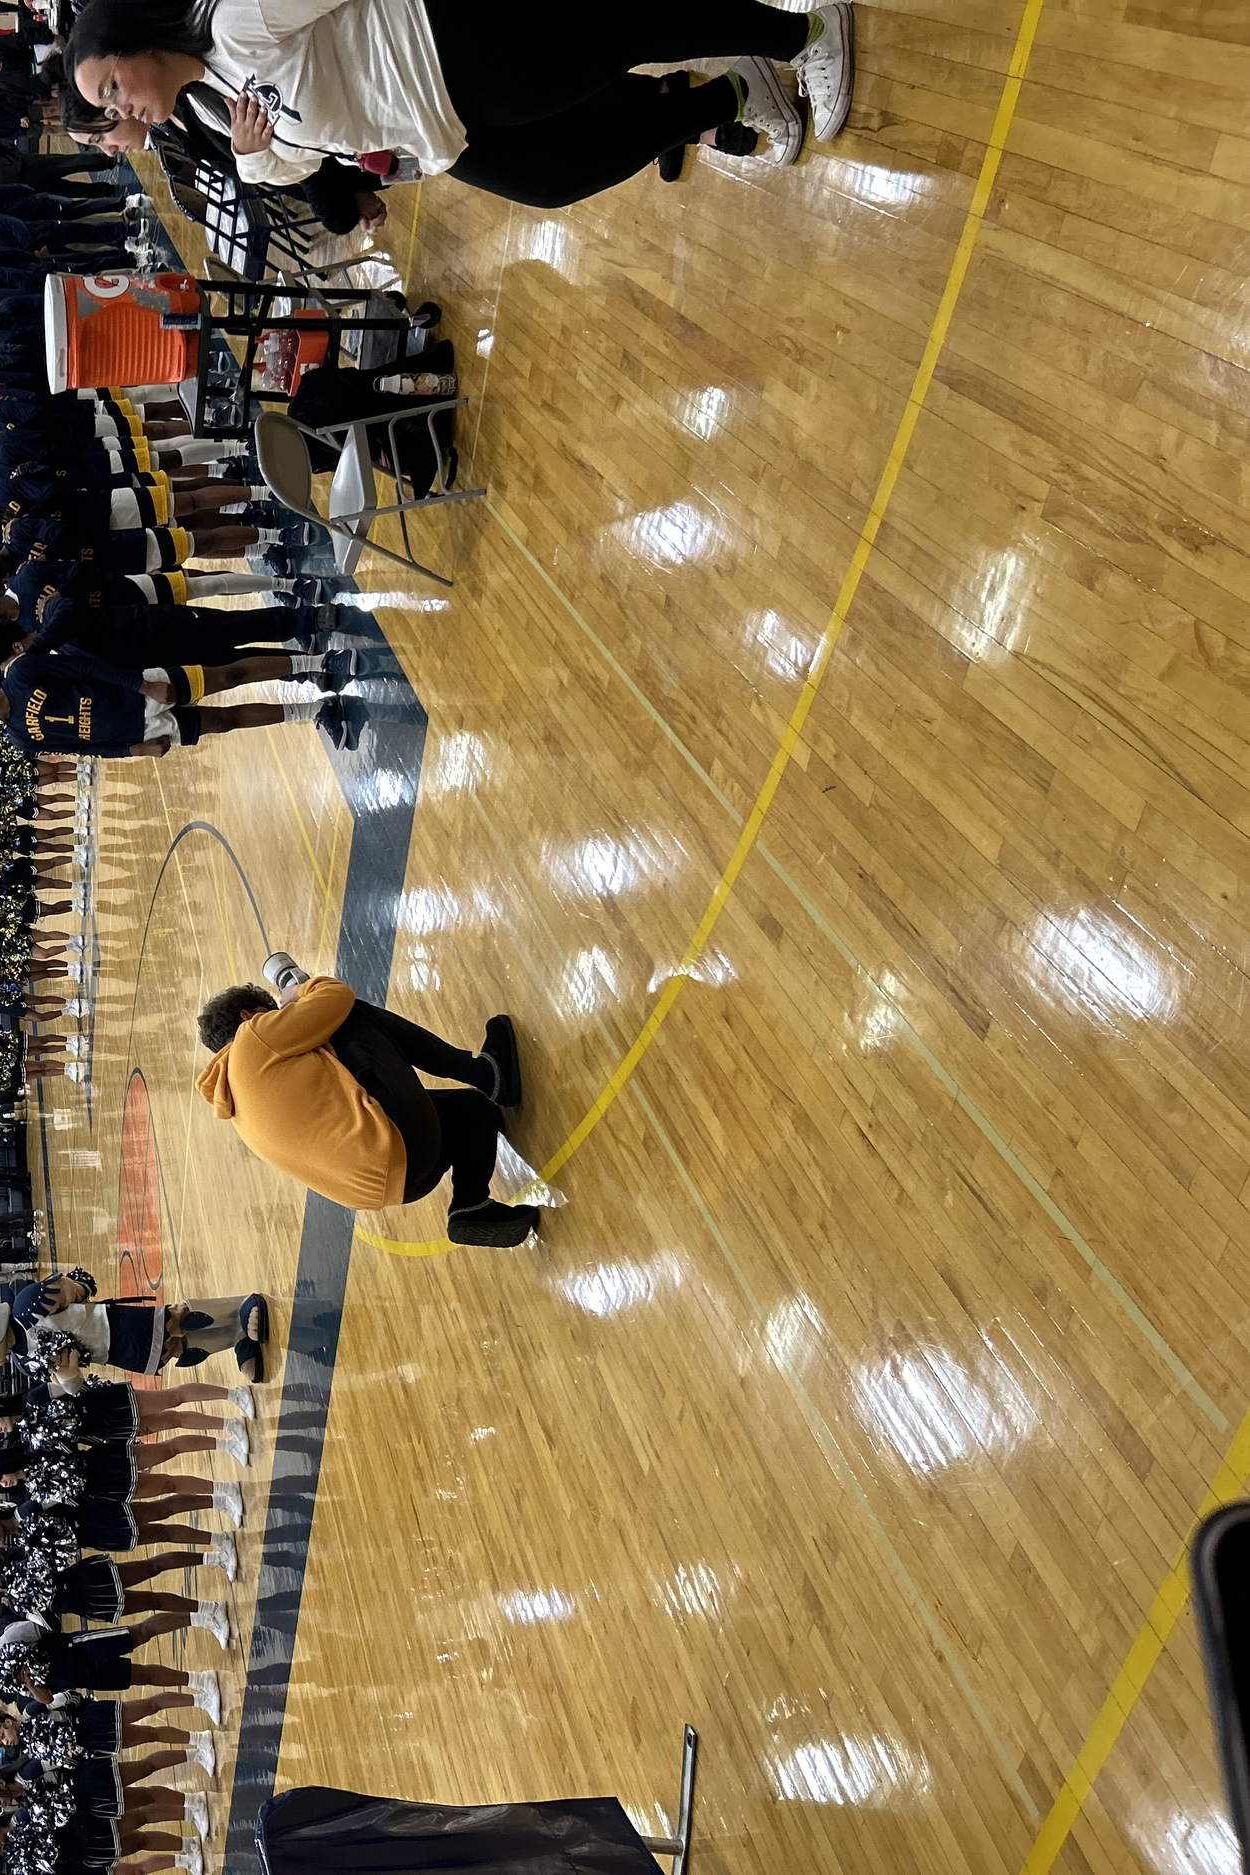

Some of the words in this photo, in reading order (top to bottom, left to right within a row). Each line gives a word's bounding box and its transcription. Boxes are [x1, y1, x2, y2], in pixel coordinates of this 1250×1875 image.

[25, 689, 47, 740] GARFIELD
[45, 715, 74, 724] 1
[78, 697, 92, 740] HEIGHTS
